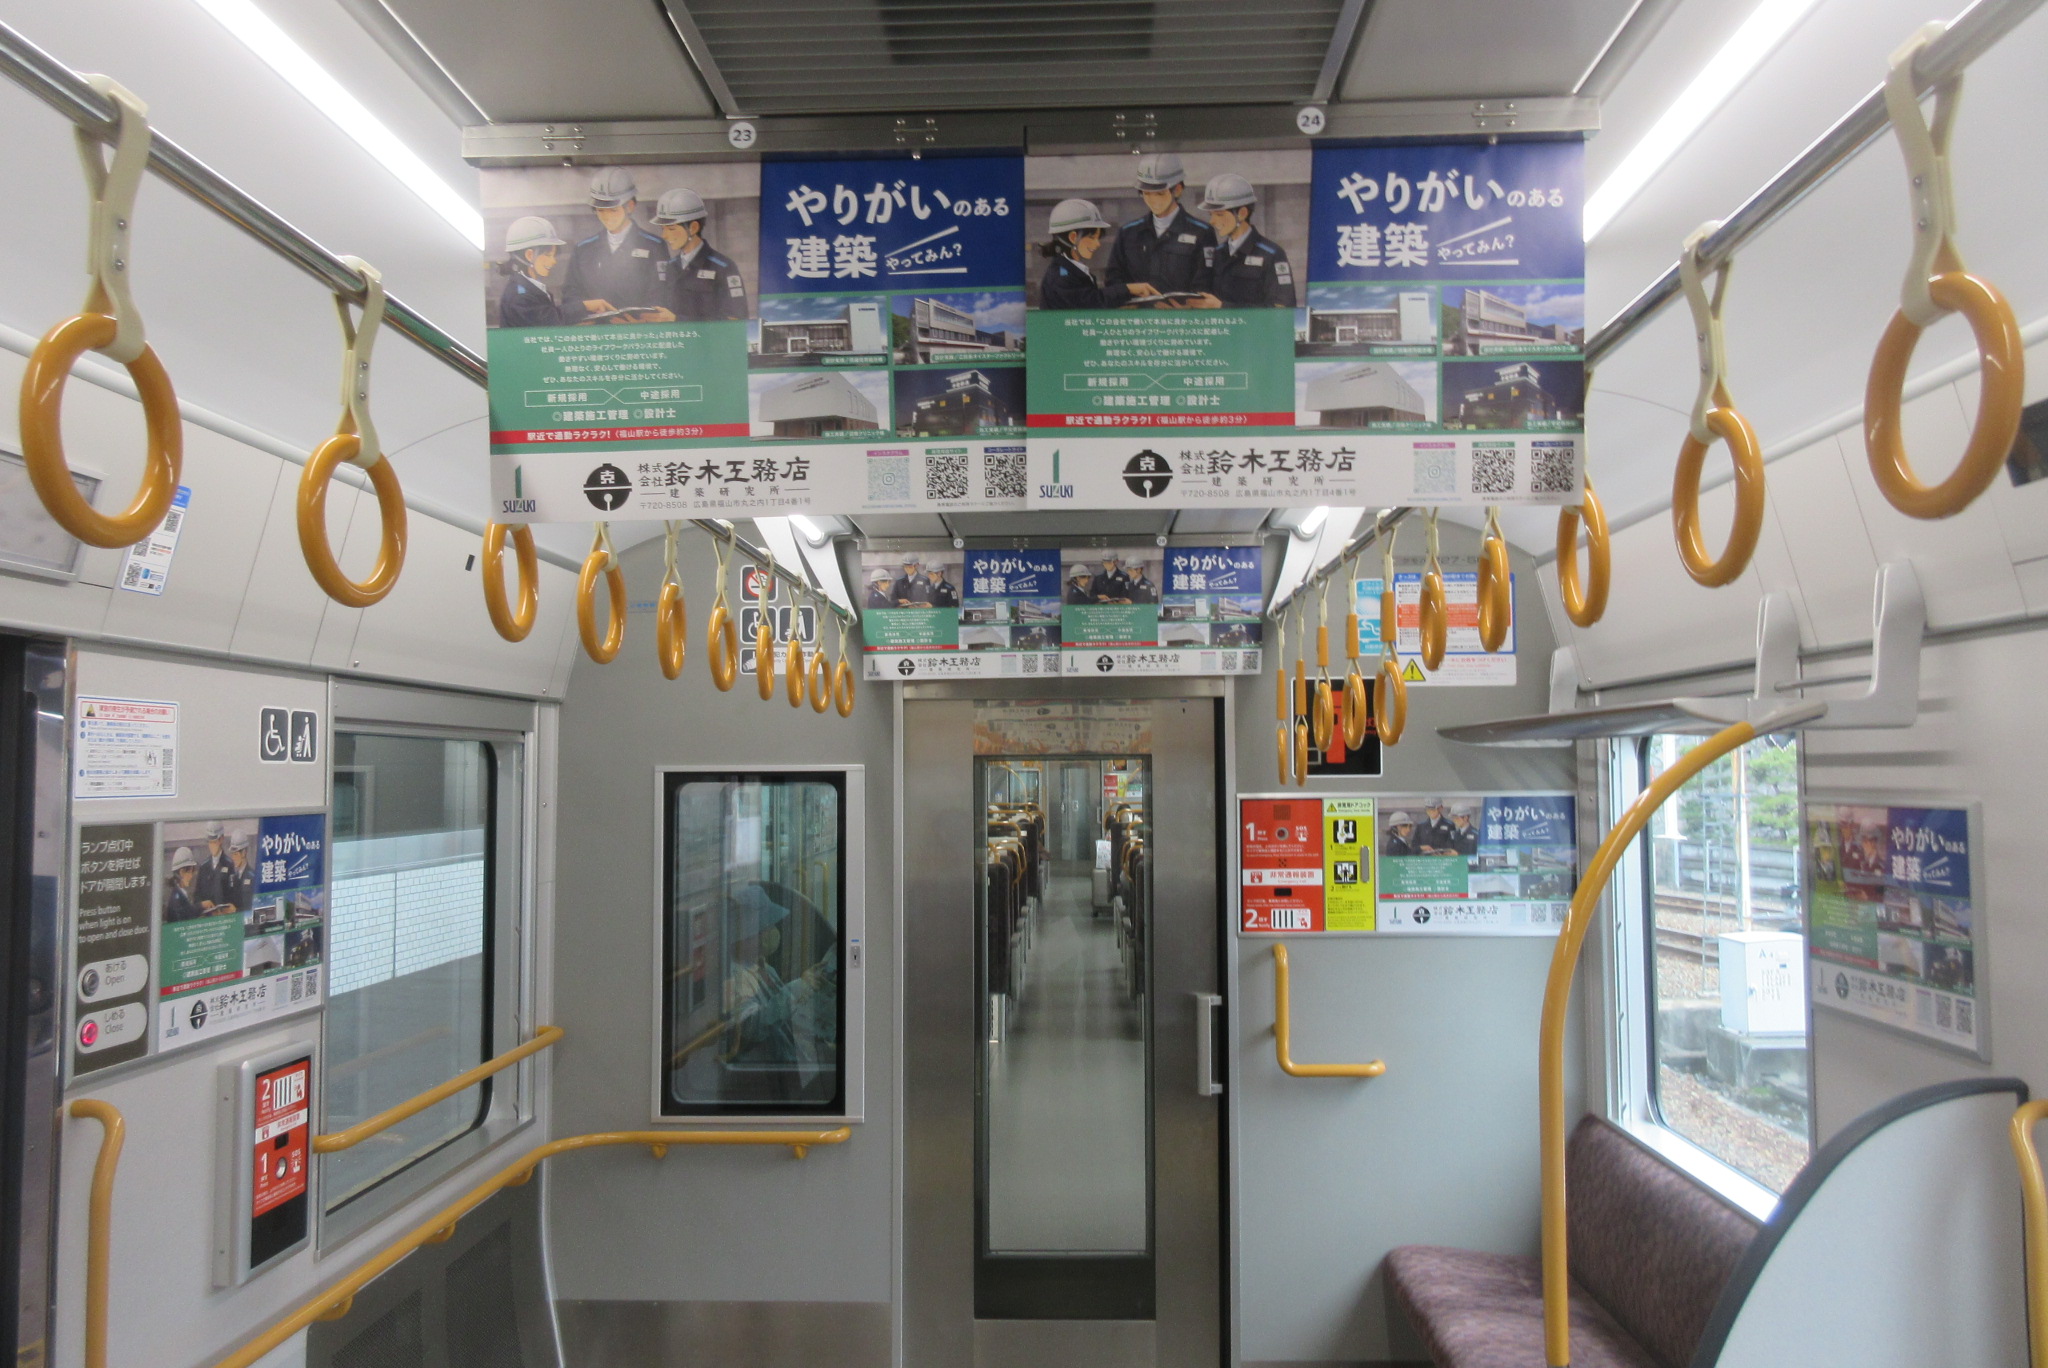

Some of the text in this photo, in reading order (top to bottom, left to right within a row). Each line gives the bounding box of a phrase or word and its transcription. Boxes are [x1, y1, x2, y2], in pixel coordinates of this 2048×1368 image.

[1300, 114, 1321, 128] 24
[733, 128, 752, 142] 23
[1336, 169, 1564, 214] やりがいのある
[786, 179, 1009, 226] やりがいのある
[1336, 222, 1428, 268] 建築
[786, 234, 877, 279] 建築
[640, 389, 680, 400] 中途採用
[1206, 446, 1356, 475] 鈴木工務店
[664, 456, 810, 487] 鈴木工務店
[973, 577, 1006, 594] 建築
[1172, 573, 1206, 590] 建築
[1246, 822, 1255, 841] 1
[81, 838, 134, 855] ランプ点灯中
[80, 856, 141, 874] ボタンを押せば
[261, 859, 286, 883] 建築
[79, 905, 121, 917] Press button
[1245, 908, 1258, 928] 2
[79, 921, 99, 930] when
[100, 917, 116, 929] light
[86, 933, 105, 943] open
[105, 929, 118, 939] and
[118, 927, 134, 937] close
[105, 960, 127, 973] あける
[105, 975, 125, 986] Open
[104, 1009, 126, 1022] しめる
[105, 1023, 124, 1034] Close
[262, 1079, 270, 1100] 2
[261, 1152, 268, 1174] 1
